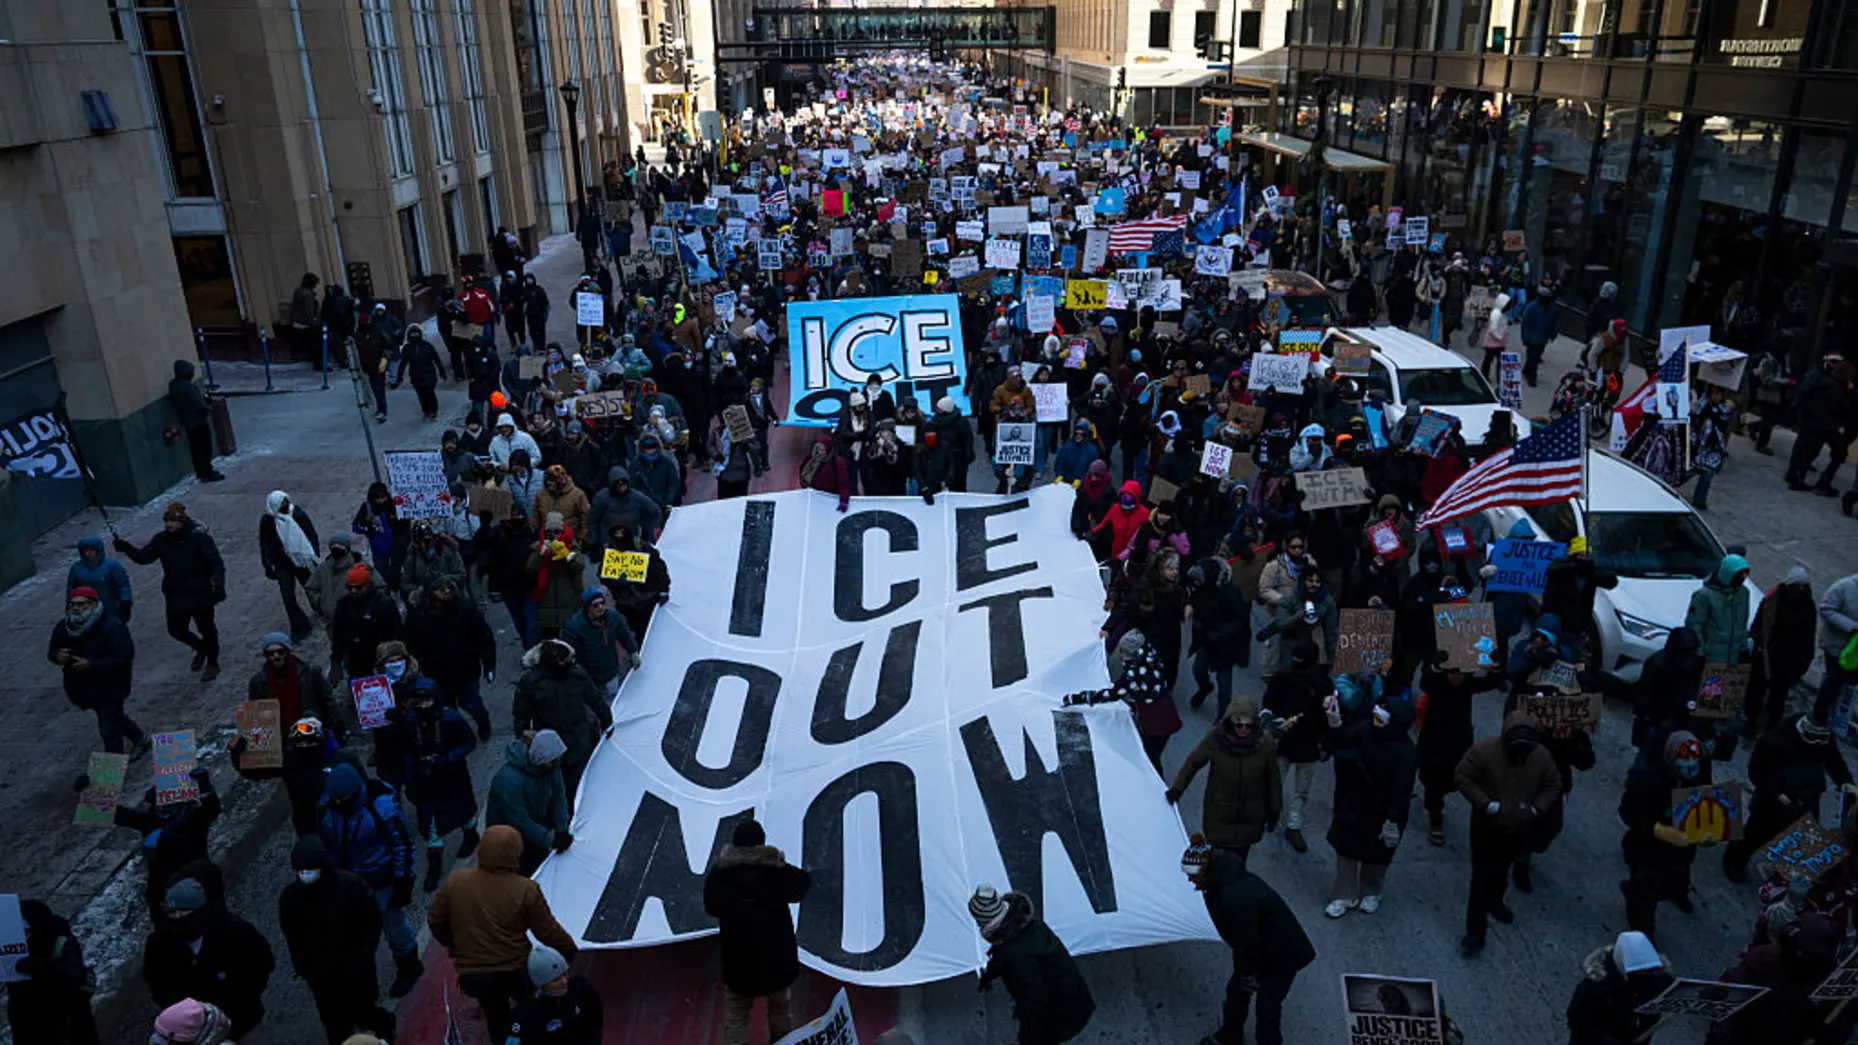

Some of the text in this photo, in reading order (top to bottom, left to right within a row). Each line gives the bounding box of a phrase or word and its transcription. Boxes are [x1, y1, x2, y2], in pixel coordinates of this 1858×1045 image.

[801, 310, 956, 391] ICE
[582, 398, 623, 417] RESIS
[1303, 470, 1353, 487] ICE
[729, 498, 1038, 637] ICE
[1502, 541, 1559, 560] JUSTICE
[660, 586, 1053, 790] OUT
[582, 709, 1117, 971] NOW
[1351, 1015, 1440, 1040] JUSTICE
